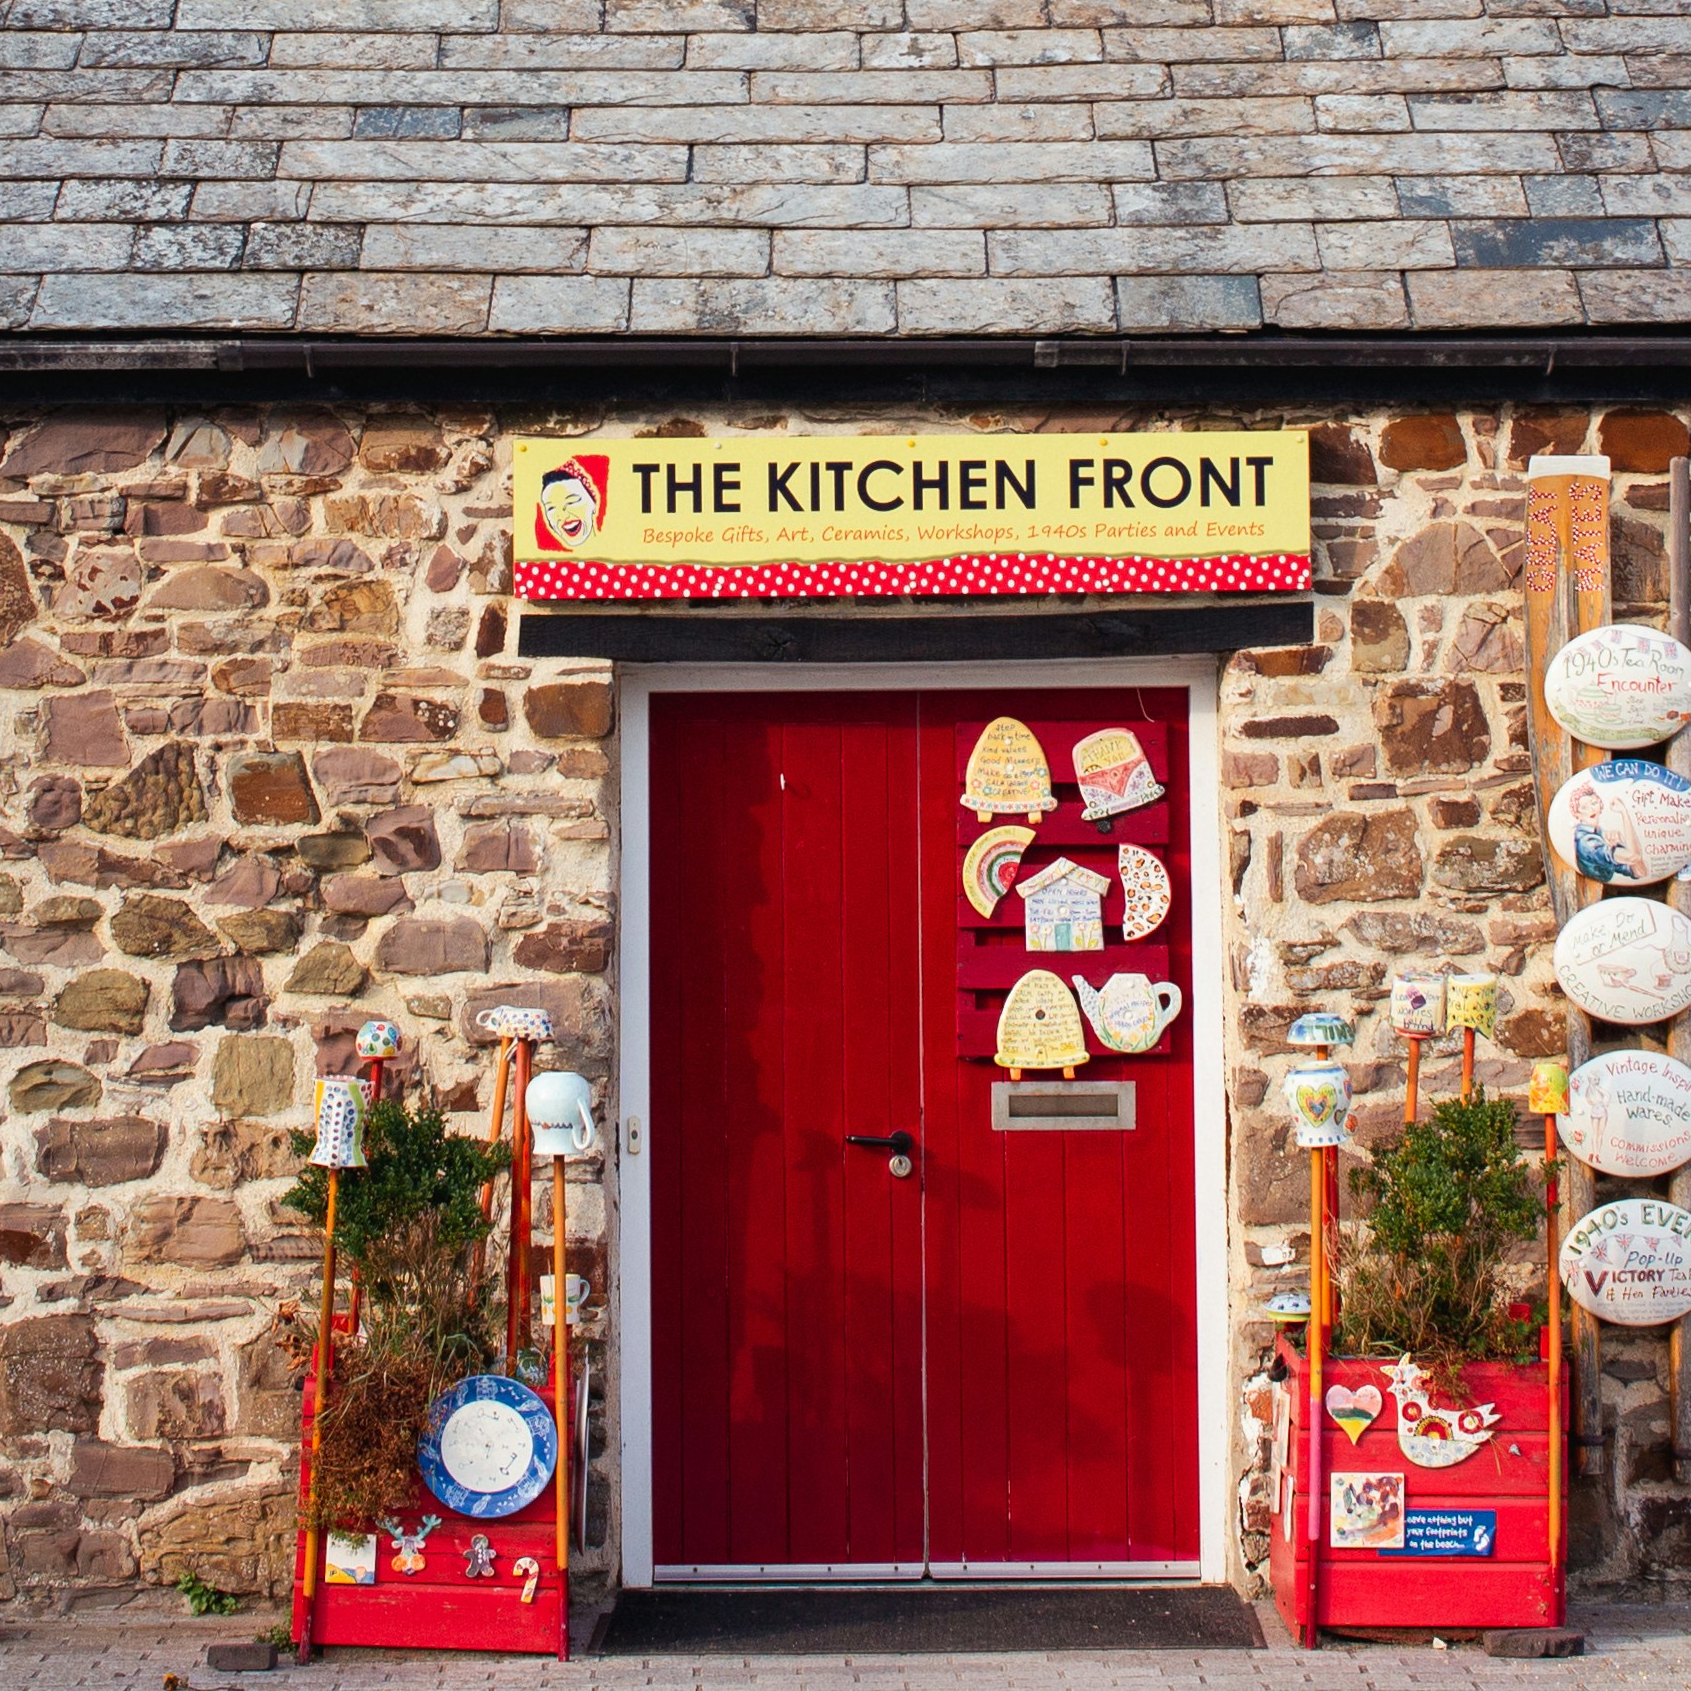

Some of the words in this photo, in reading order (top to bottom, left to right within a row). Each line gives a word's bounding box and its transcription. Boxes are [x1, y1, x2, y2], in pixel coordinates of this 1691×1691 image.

[632, 462, 741, 513] THE
[768, 458, 1036, 512] KITCHEN
[1069, 456, 1274, 508] FRONT
[643, 526, 714, 548] Bespoke
[721, 526, 770, 544] Gifts,
[776, 526, 815, 543] Art,
[822, 524, 910, 543] Ceramics,
[917, 523, 1020, 545] Workshops,
[1026, 524, 1087, 539] 1940s
[1095, 522, 1157, 538] Parties
[1164, 521, 1198, 537] and
[1206, 520, 1265, 537] Events
[1526, 484, 1557, 592] GREAT
[1620, 647, 1645, 668] Tea
[1649, 649, 1685, 680] Room
[1596, 672, 1678, 696] Encounter
[1594, 765, 1613, 781] WE
[1615, 762, 1639, 776] CAN
[1643, 764, 1660, 778] DO
[1632, 789, 1655, 808] Gift
[1572, 924, 1606, 949] Make
[1615, 911, 1636, 928] Do
[1610, 919, 1645, 949] Mend
[1558, 964, 1625, 1019] CREATIVE
[1605, 1056, 1658, 1076] Vintage
[1616, 1085, 1691, 1122] Hand-made
[1567, 1205, 1629, 1256] 1940's
[1623, 1250, 1684, 1269] Pop-Up
[1583, 1269, 1666, 1298] VICTORY
[1668, 1268, 1688, 1282] Tea
[1622, 1286, 1644, 1301] Hen
[1406, 1527, 1424, 1538] your
[1425, 1526, 1468, 1539] footprints
[1426, 1514, 1457, 1527] nothing
[1457, 1514, 1474, 1527] but
[1409, 1540, 1419, 1548] on
[1419, 1539, 1435, 1551] the
